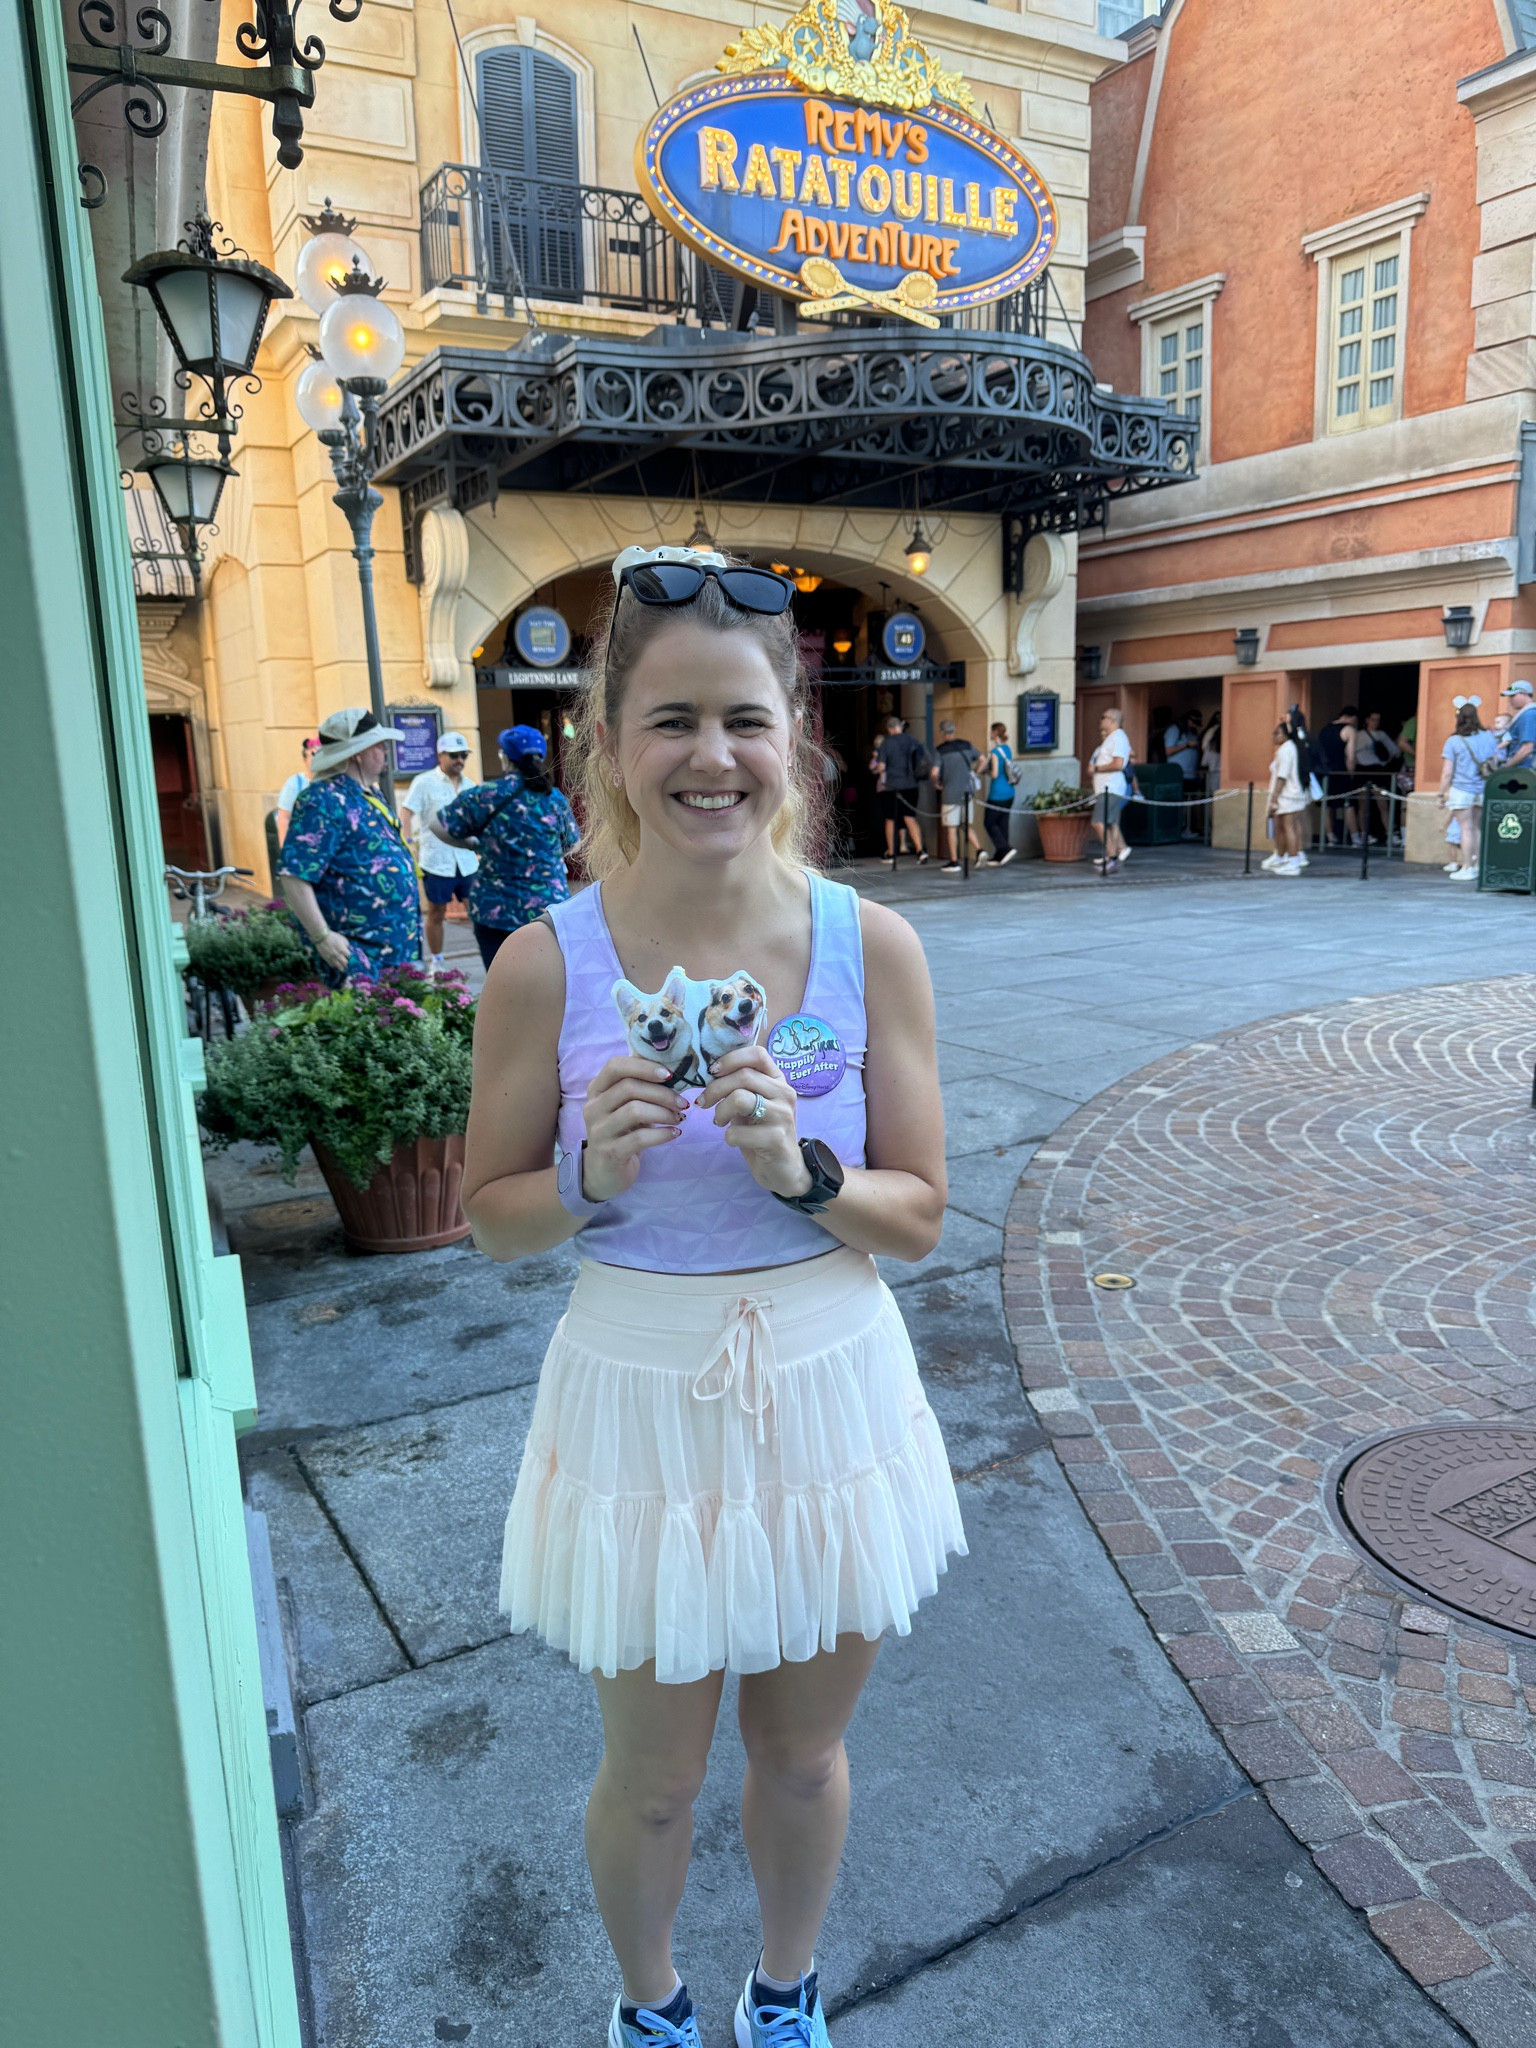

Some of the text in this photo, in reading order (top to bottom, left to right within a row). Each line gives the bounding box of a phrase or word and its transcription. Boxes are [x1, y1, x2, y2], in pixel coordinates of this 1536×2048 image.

[804, 98, 929, 165] REMY'S
[698, 125, 1019, 239] RATATOUILLE
[768, 208, 962, 279] ADVENTURE
[508, 672, 579, 685] LIGHTNING LANE
[776, 1054, 816, 1070] Happily
[790, 1062, 839, 1081] Ever After
